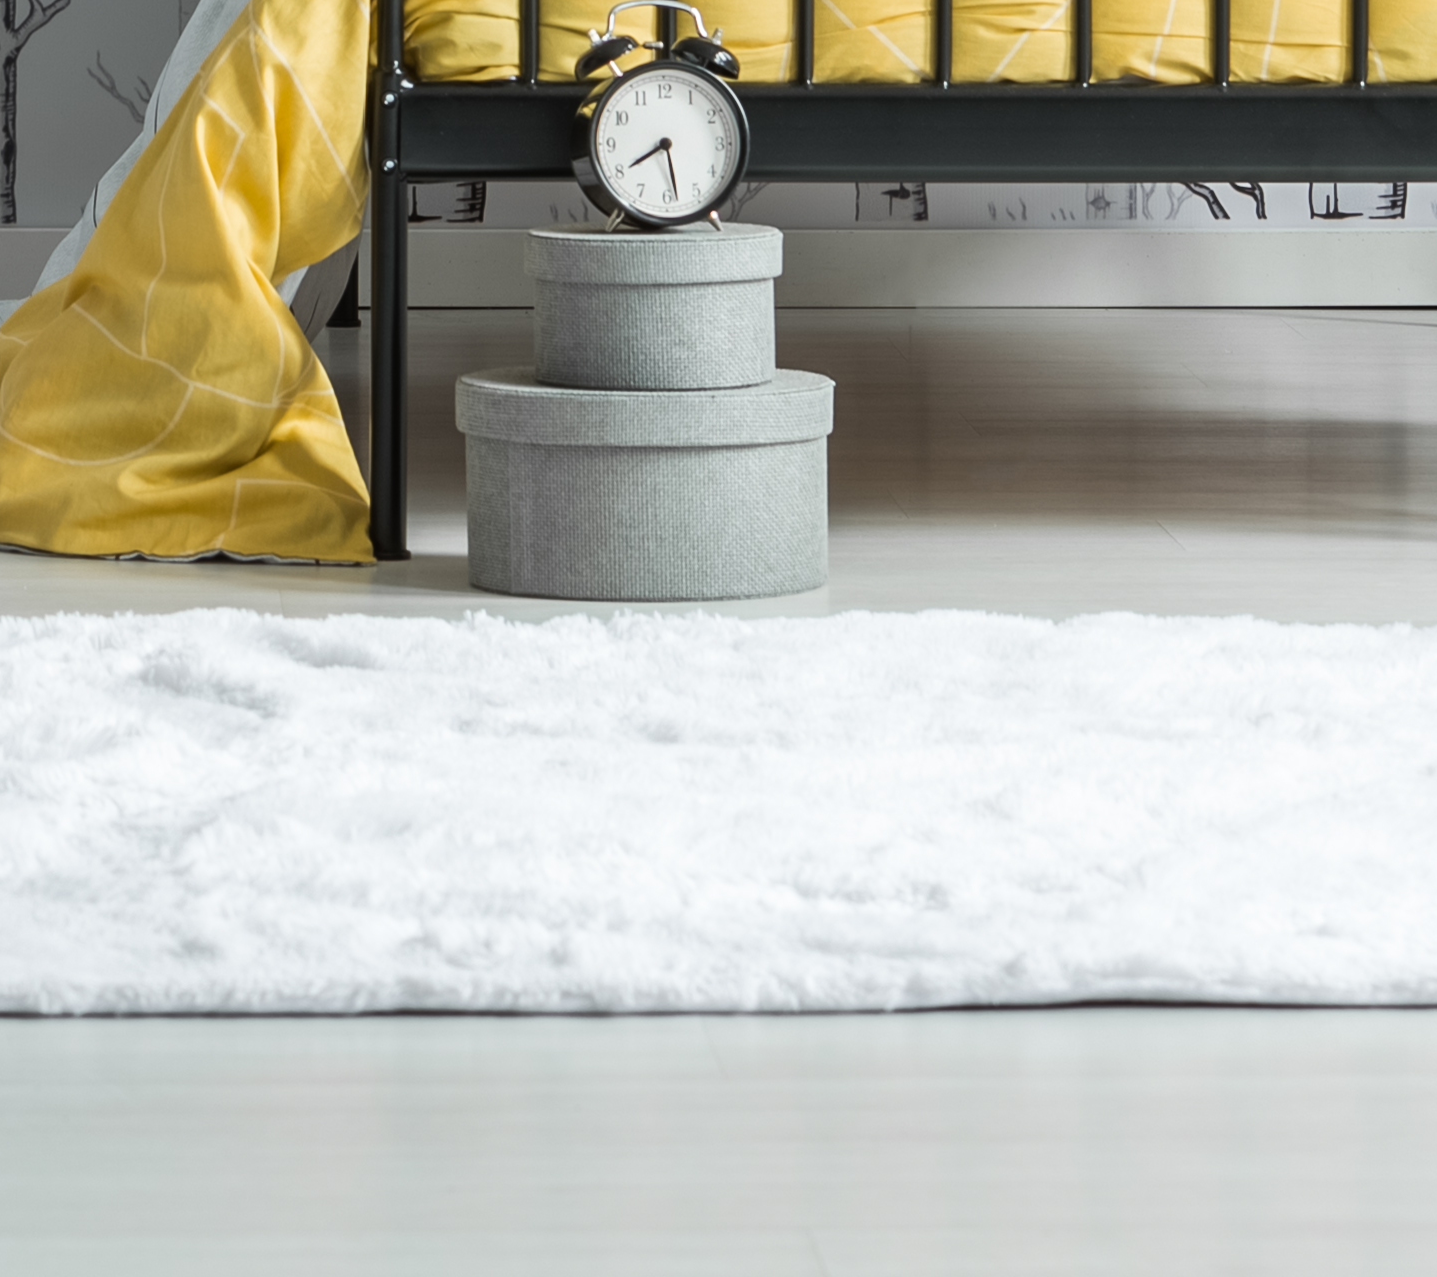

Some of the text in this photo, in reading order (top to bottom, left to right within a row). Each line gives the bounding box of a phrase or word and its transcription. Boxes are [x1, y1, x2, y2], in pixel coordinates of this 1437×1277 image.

[634, 91, 647, 106] 11
[657, 83, 672, 99] 12
[688, 89, 693, 105] 1
[615, 111, 629, 126] 10
[707, 109, 717, 124] 2
[606, 137, 616, 153] 9
[715, 136, 725, 151] 3
[615, 165, 625, 179] 8
[707, 164, 717, 178] 4
[637, 183, 646, 198] 7
[662, 189, 672, 204] 6
[692, 183, 701, 197] 5
